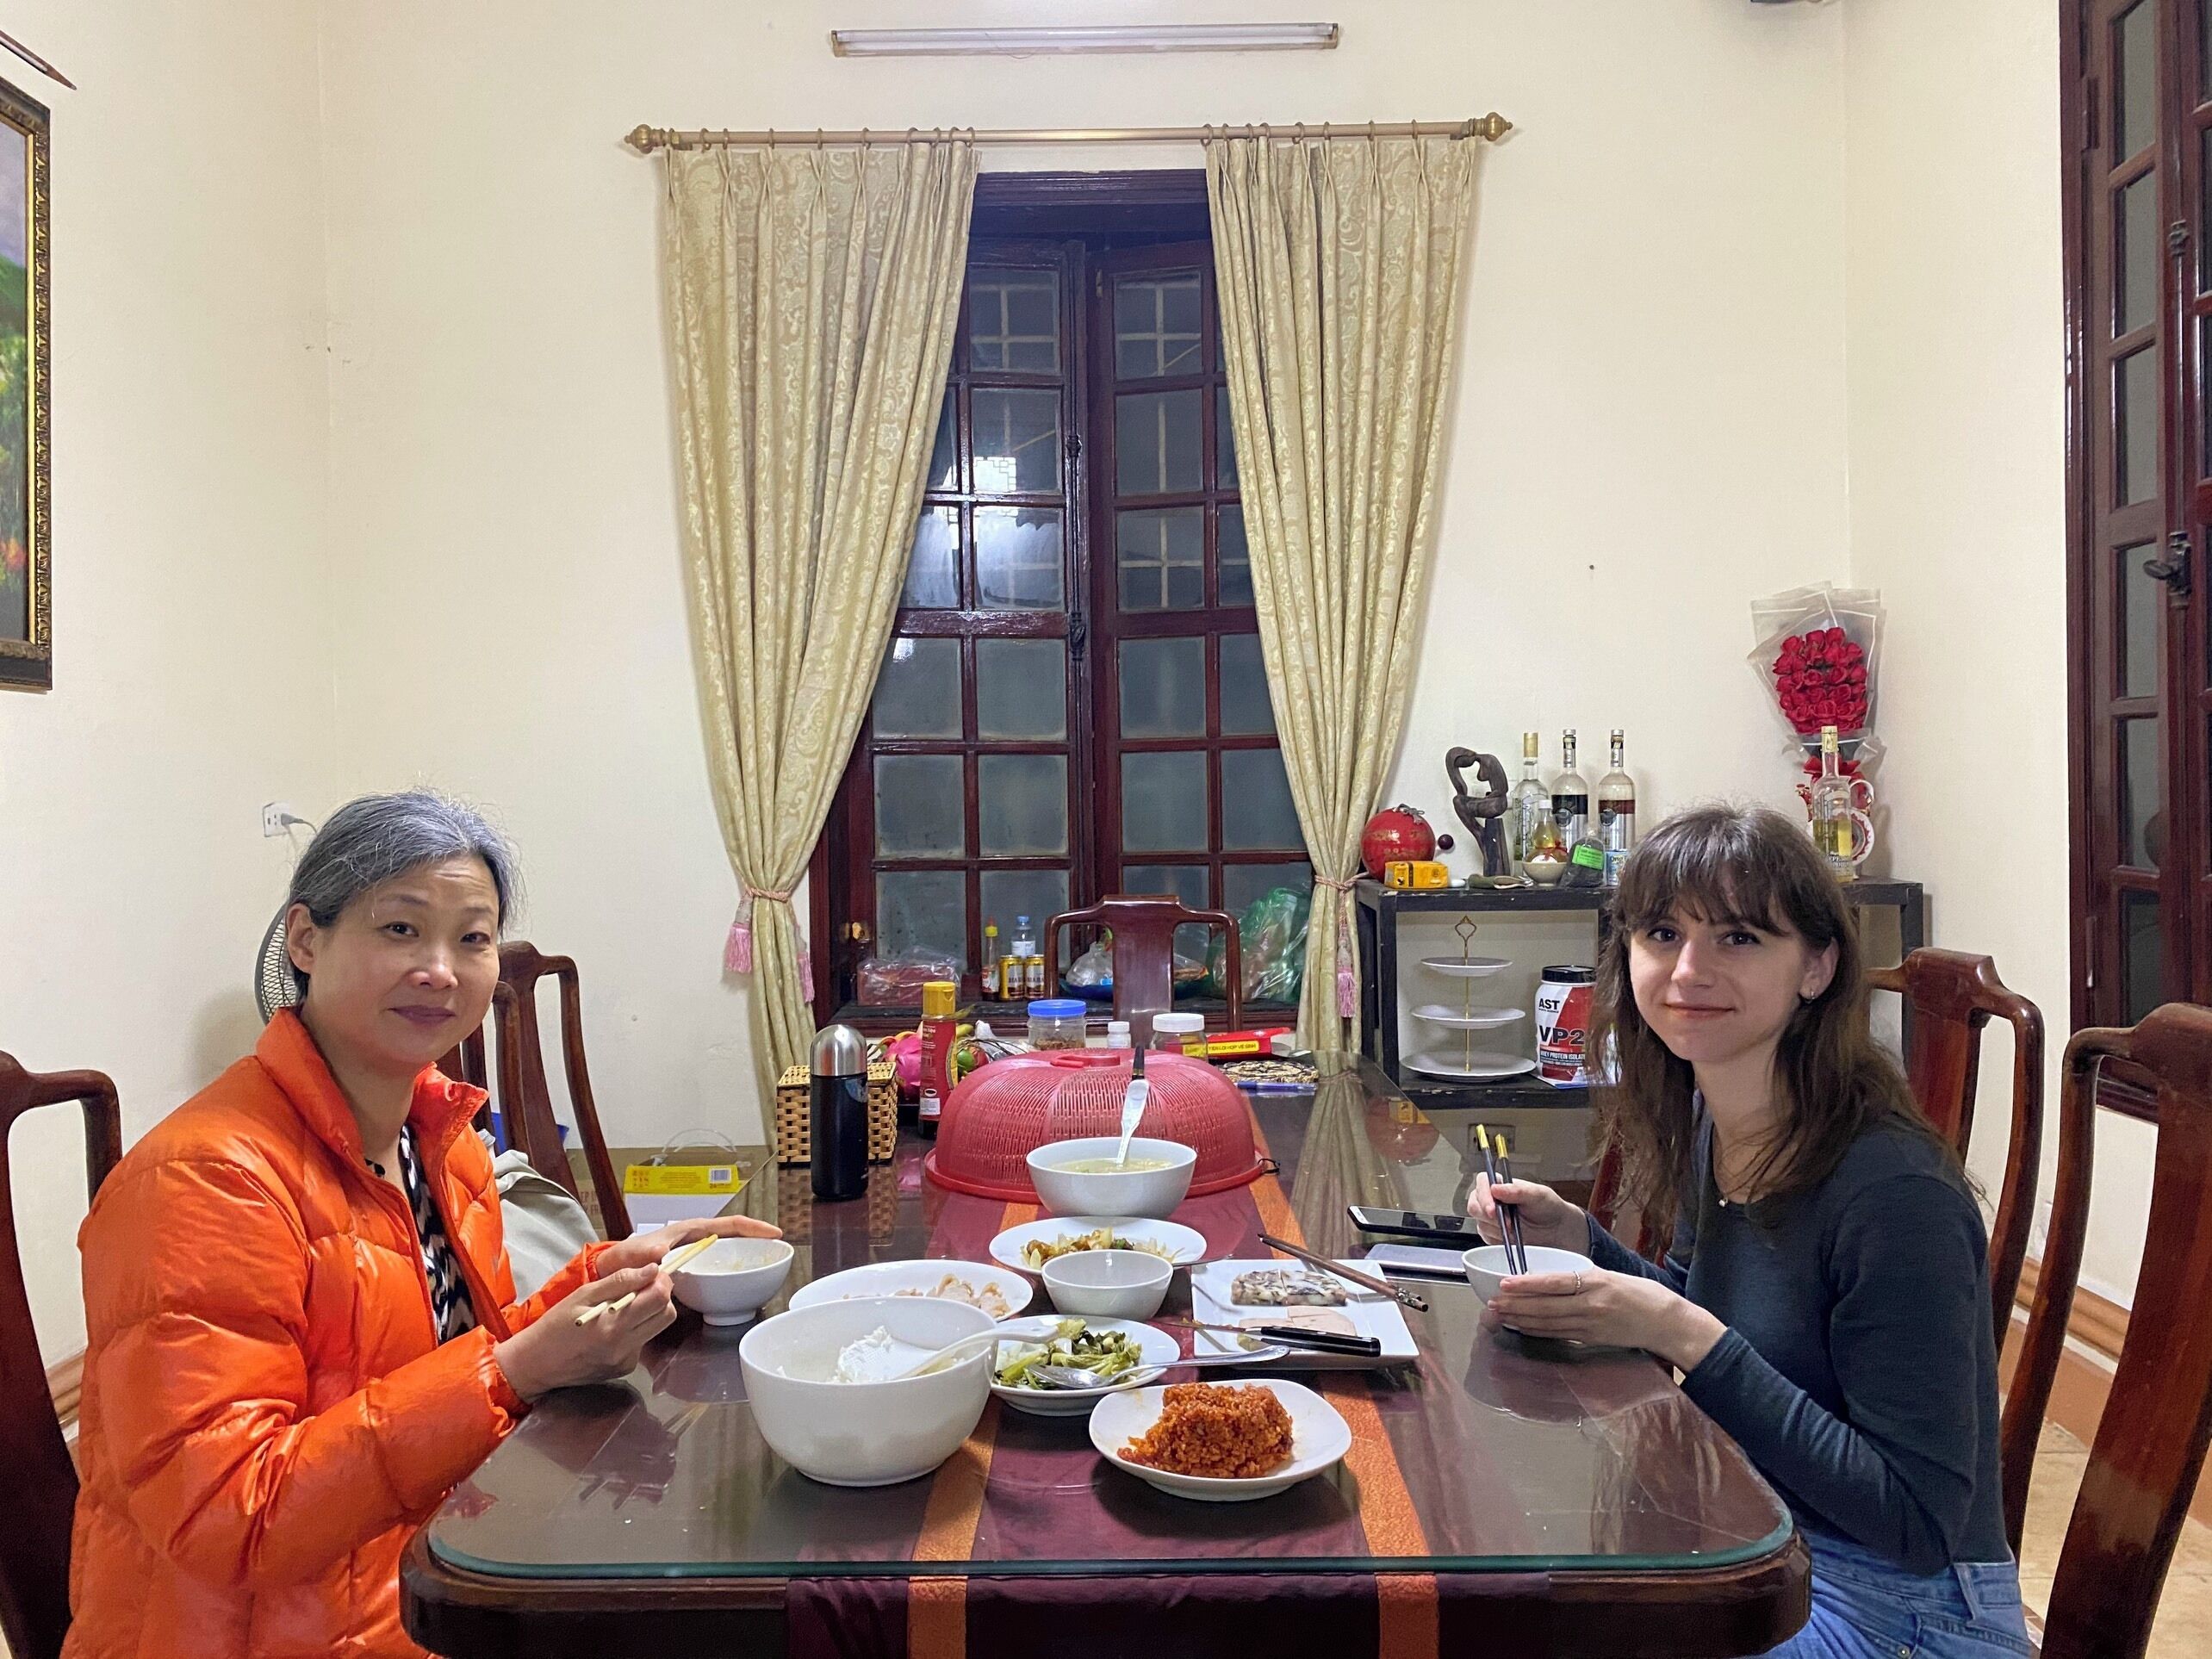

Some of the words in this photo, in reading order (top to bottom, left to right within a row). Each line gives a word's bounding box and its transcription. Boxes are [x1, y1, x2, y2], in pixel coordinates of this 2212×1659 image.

[1538, 997, 1560, 1010] AST
[1538, 1024, 1585, 1046] VP2
[1550, 1051, 1568, 1059] PROTEIN
